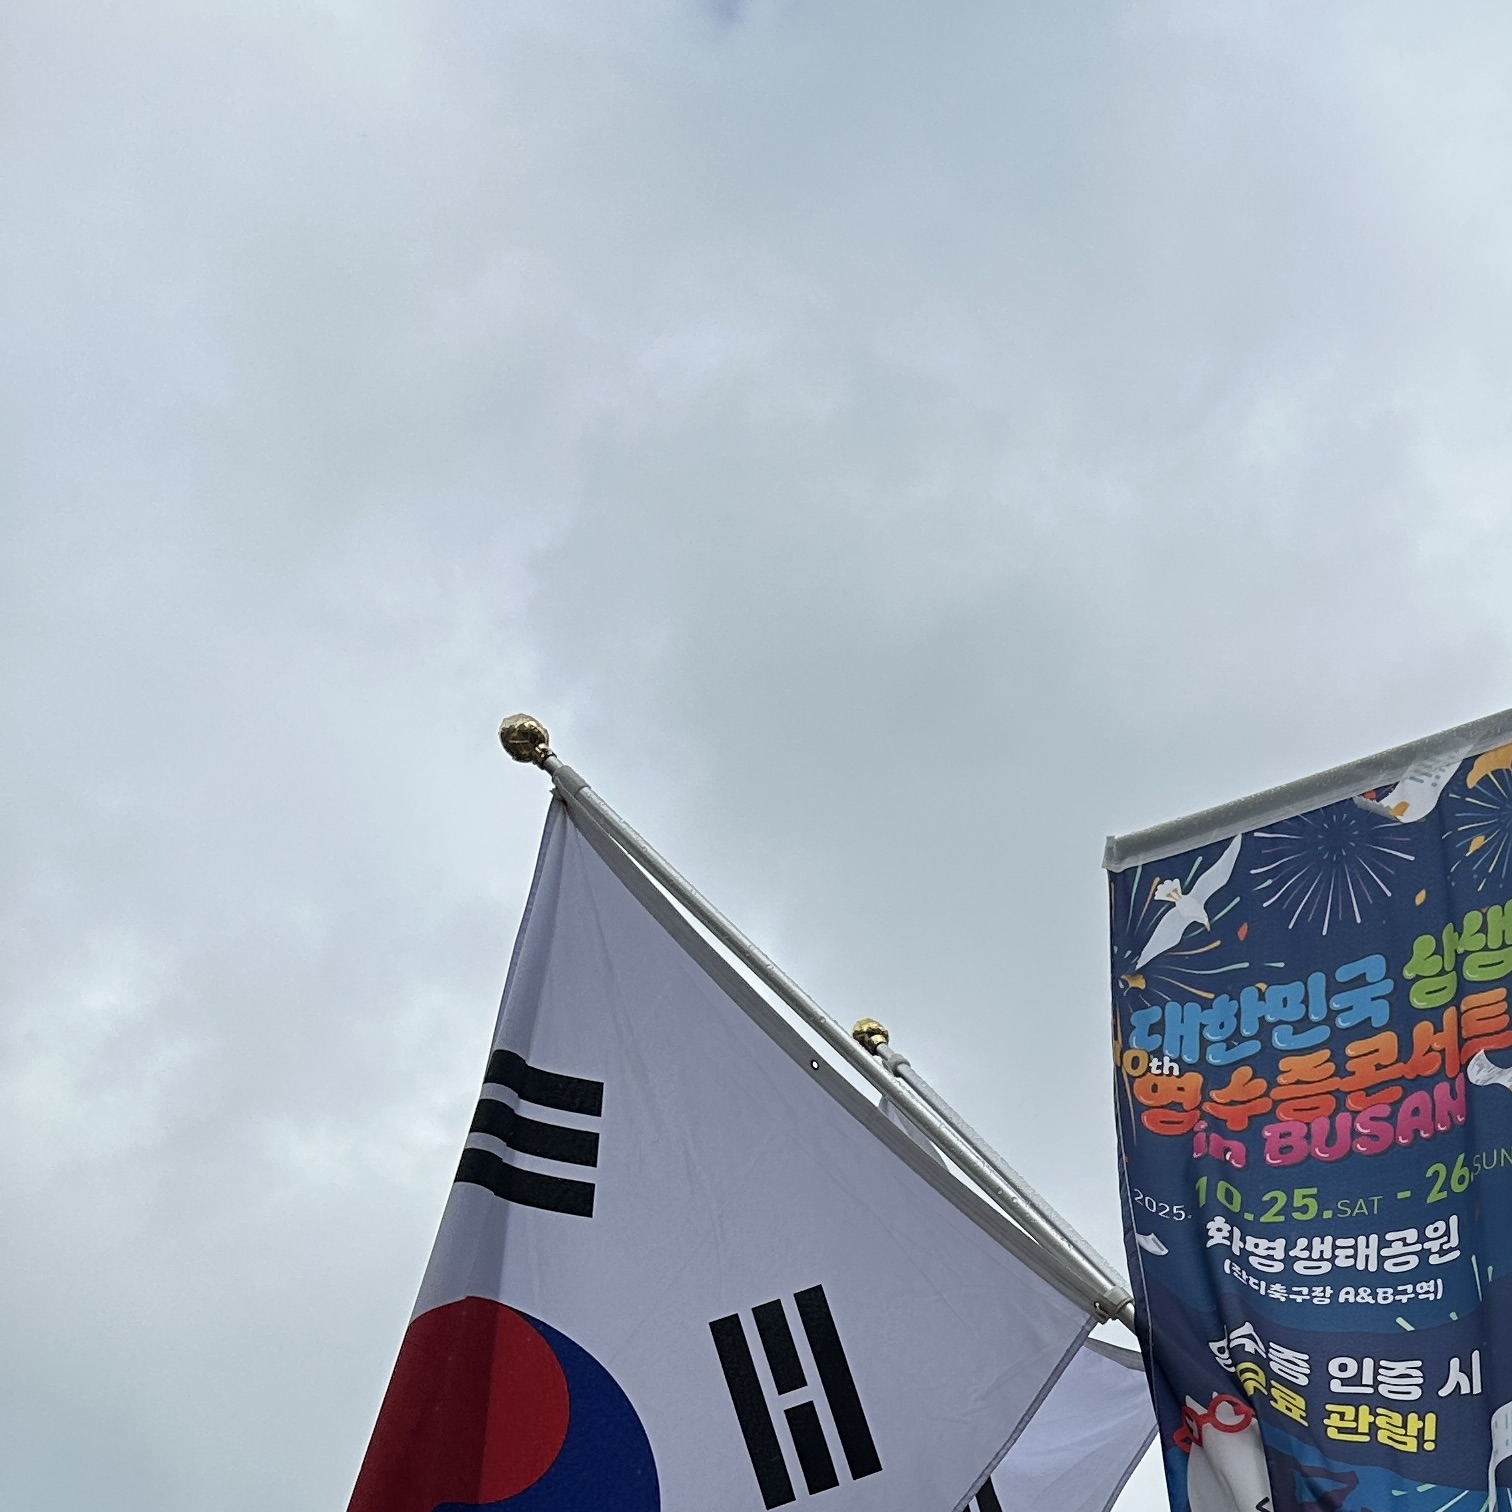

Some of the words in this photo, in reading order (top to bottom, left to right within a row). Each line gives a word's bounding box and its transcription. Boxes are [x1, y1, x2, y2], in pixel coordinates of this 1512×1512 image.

[1129, 954, 1395, 1066] 대한민국
[1192, 1120, 1247, 1168] in
[1262, 1071, 1468, 1168] BUSAN
[1205, 1214, 1461, 1276] 화명생태공원
[1327, 1356, 1425, 1401] 인증
[1437, 1349, 1483, 1398] 시
[1323, 1403, 1438, 1452] 관람!
